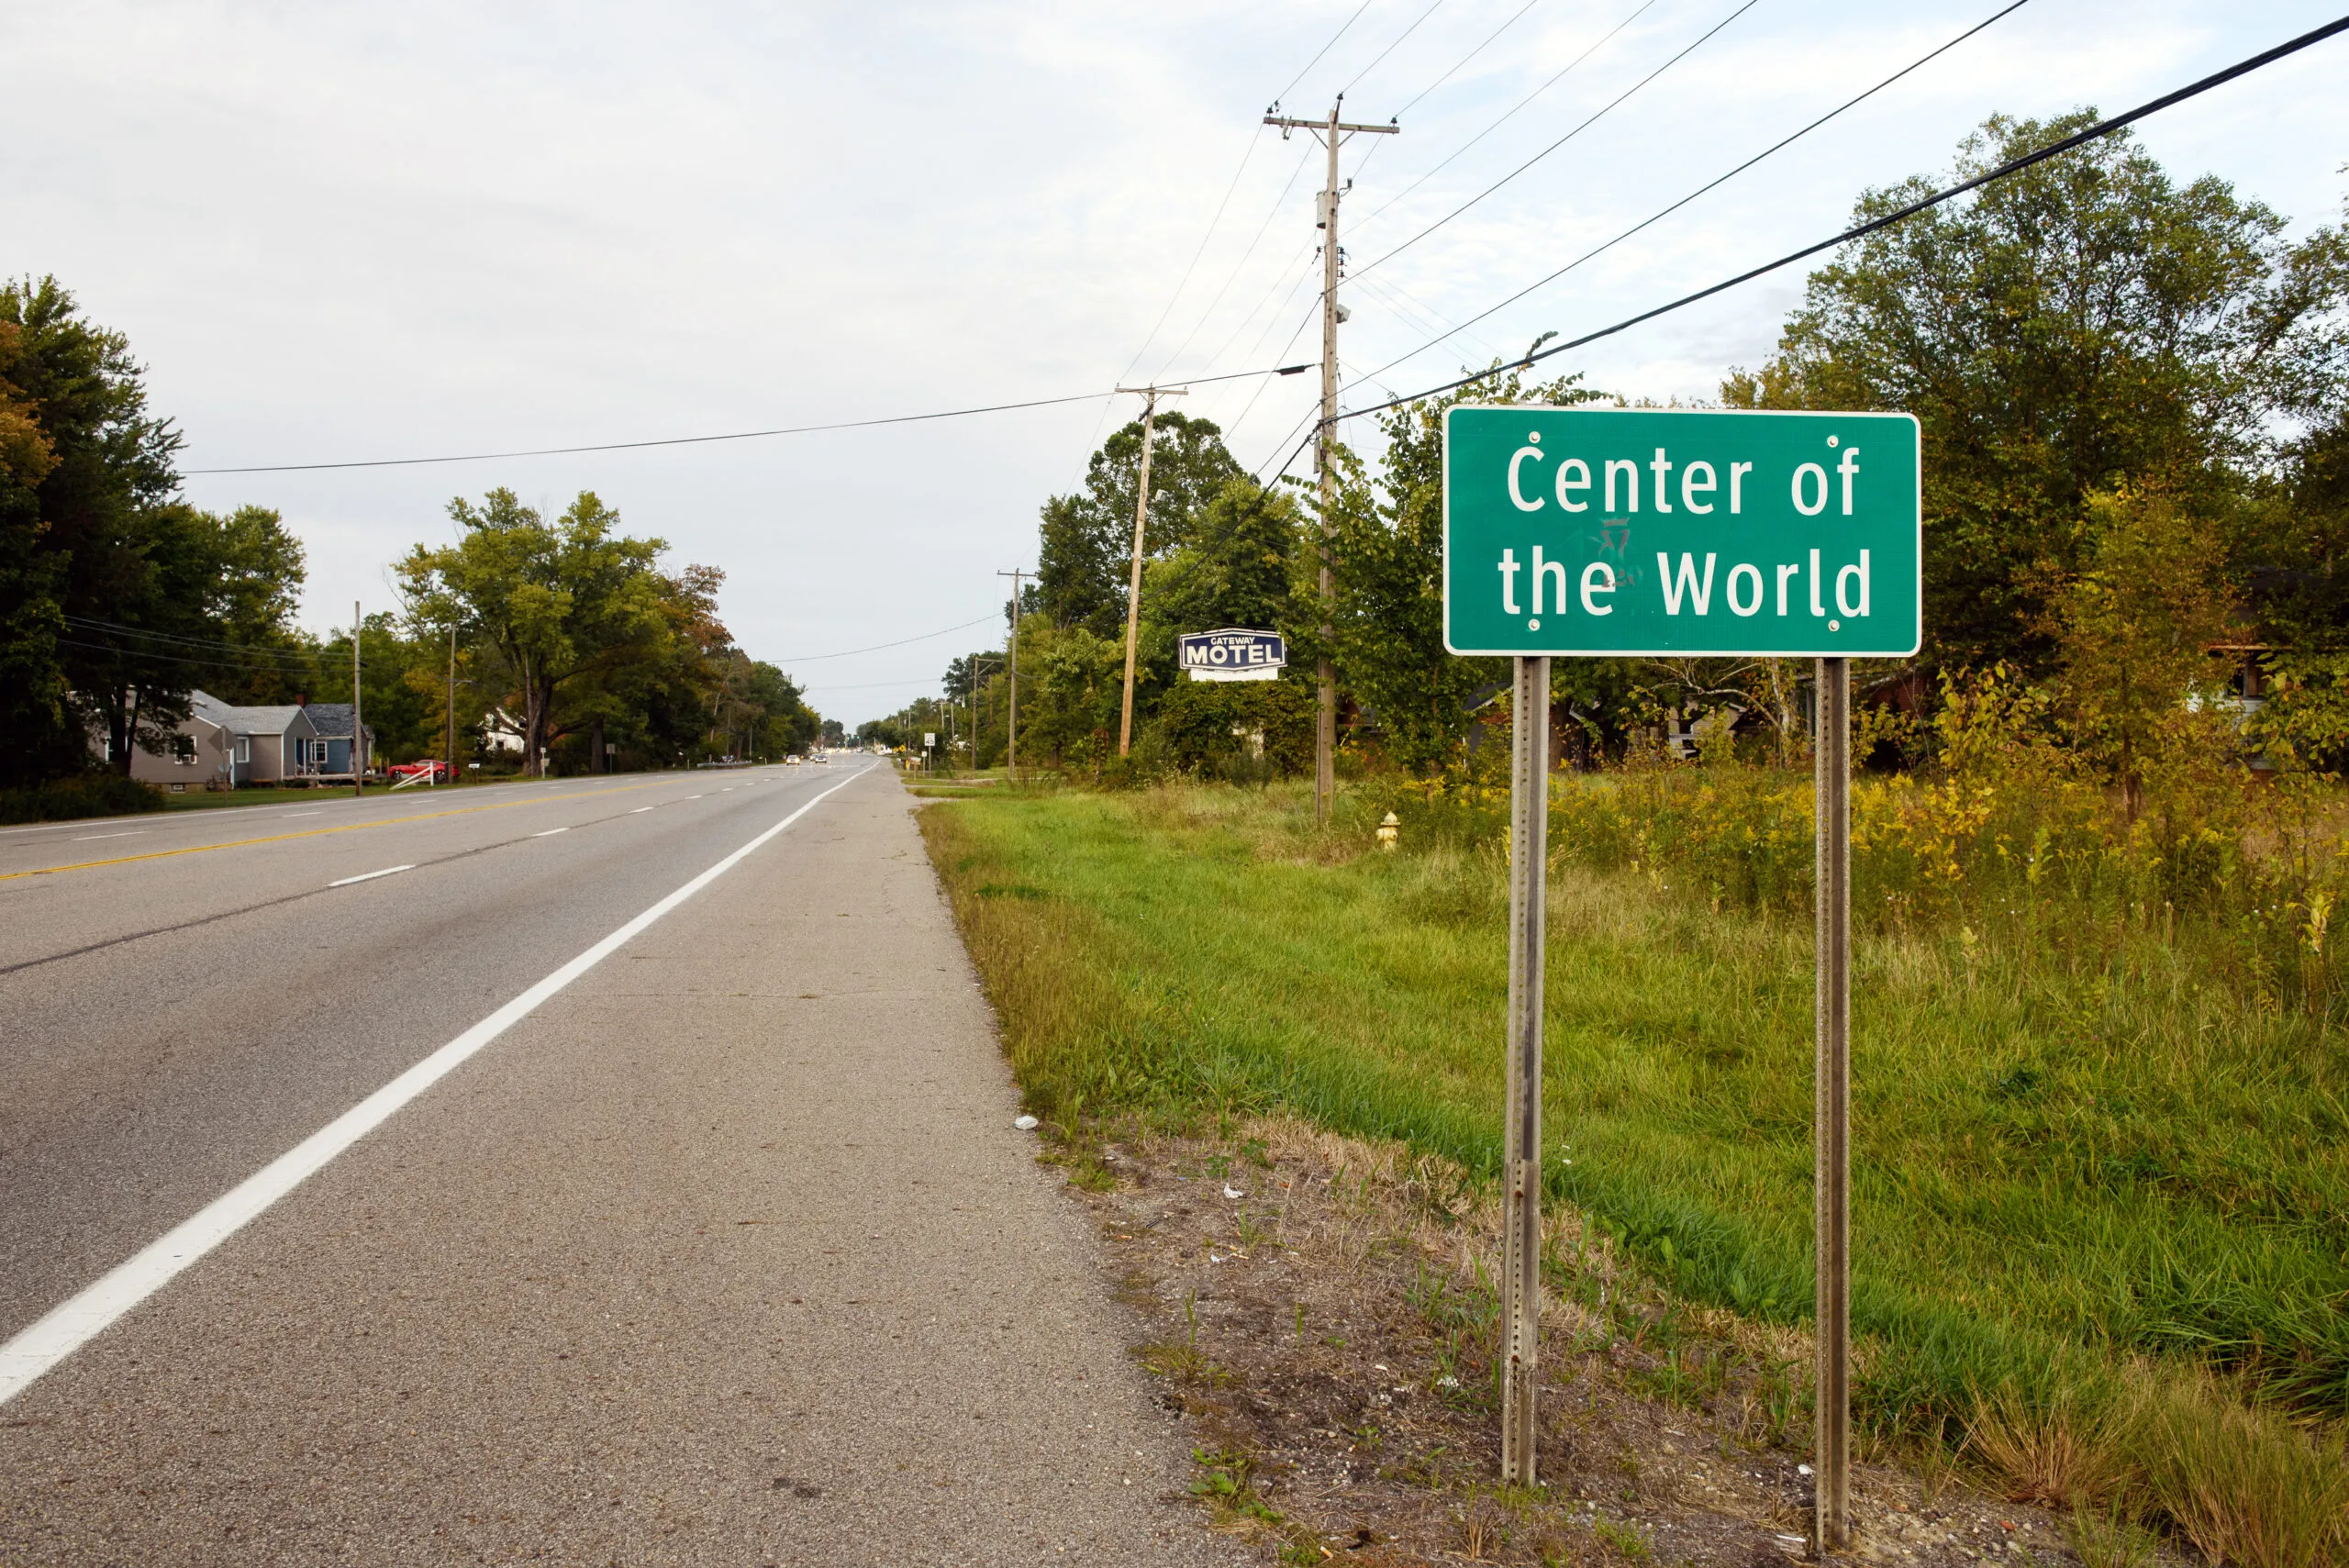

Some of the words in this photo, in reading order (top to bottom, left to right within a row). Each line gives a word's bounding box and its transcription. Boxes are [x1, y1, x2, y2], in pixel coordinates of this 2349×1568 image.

[1508, 446, 1753, 515] Center
[1791, 447, 1860, 517] of
[1497, 545, 1617, 617] the
[1656, 548, 1870, 617] World
[1186, 644, 1281, 664] MOTEL
[1210, 637, 1255, 645] GATEWAY
